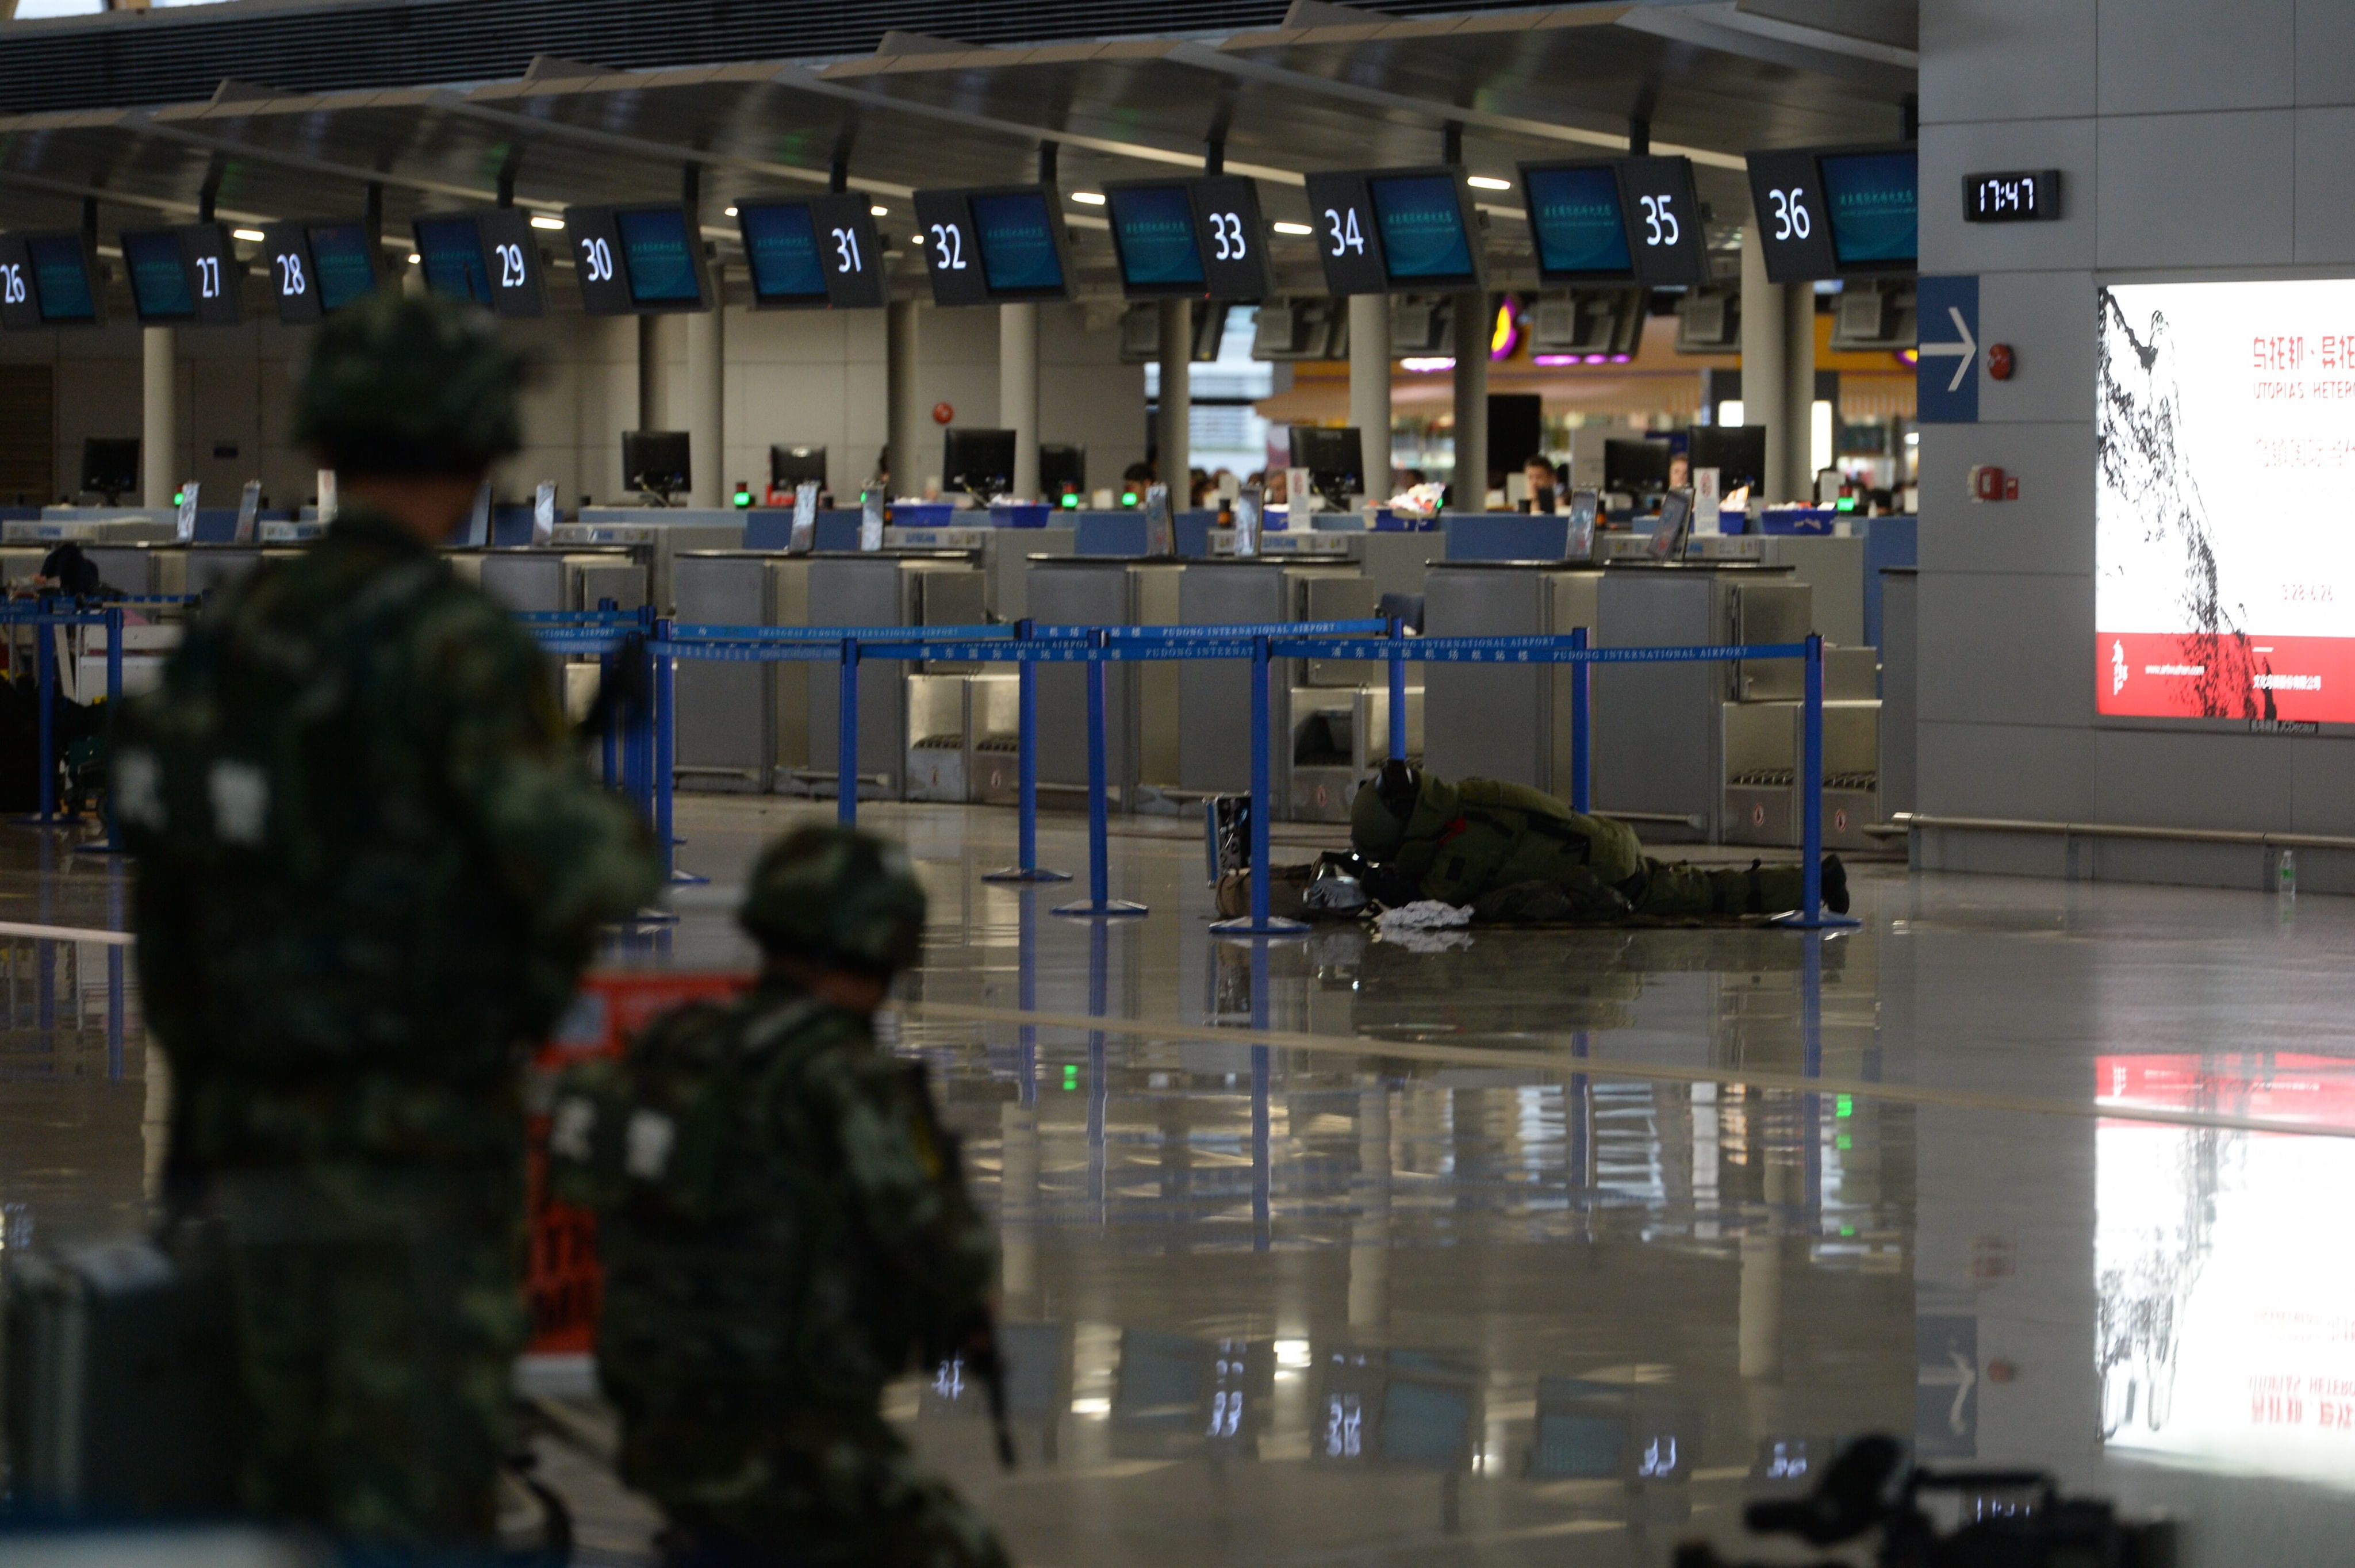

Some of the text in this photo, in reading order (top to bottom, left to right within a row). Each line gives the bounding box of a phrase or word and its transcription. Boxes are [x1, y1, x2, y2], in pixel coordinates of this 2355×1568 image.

[1770, 188, 1809, 240] 36
[1981, 179, 2033, 212] 17:47
[1210, 213, 1245, 259] 33
[1325, 208, 1363, 256] 34
[1640, 195, 1678, 245] 35
[496, 244, 524, 286] 29
[582, 238, 612, 281] 30
[832, 228, 861, 272] 31
[931, 224, 966, 269] 32
[0, 264, 25, 302] 26
[197, 258, 218, 297] 27
[277, 254, 304, 295] 28
[2253, 381, 2355, 398] UTOPIAS HETER
[846, 628, 914, 637] INTERNATIONAL
[920, 627, 956, 636] AIRPORT
[1161, 623, 1336, 637] PUDONG INTERNATIONAL AIRPORT
[1418, 638, 1504, 648] INTERNATIONAL
[1508, 637, 1555, 647] AIRPORT
[1144, 648, 1192, 658] PUDONG
[1329, 647, 1526, 661] 浦东国际机场航站楼
[1551, 647, 1744, 661] PUDONG INTERNATIONAL AIRPORT
